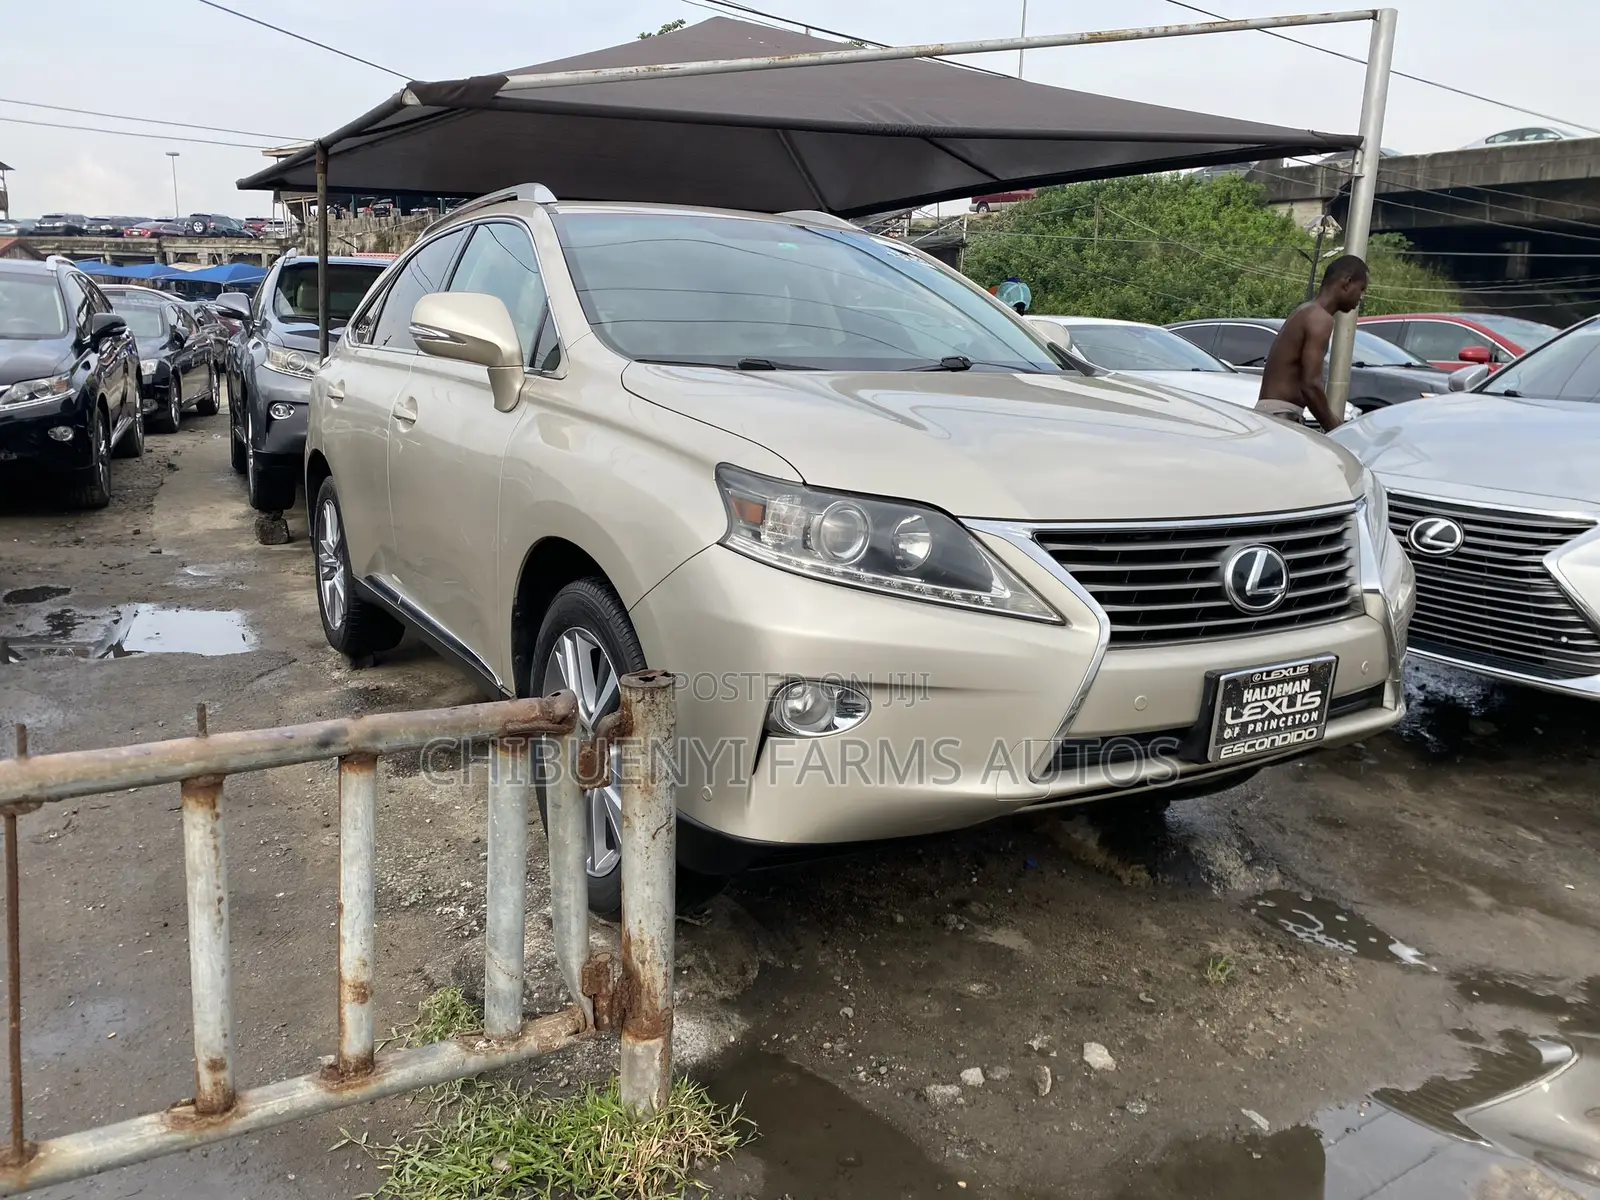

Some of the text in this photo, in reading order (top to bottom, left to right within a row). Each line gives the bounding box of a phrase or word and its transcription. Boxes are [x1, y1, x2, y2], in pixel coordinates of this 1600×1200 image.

[1263, 665, 1309, 680] LEXUS
[1243, 679, 1311, 703] HALDEMAN
[1225, 690, 1322, 724] LEXUS
[1223, 711, 1319, 740] OF PRINCETON
[1220, 728, 1317, 759] ESCONDIDO
